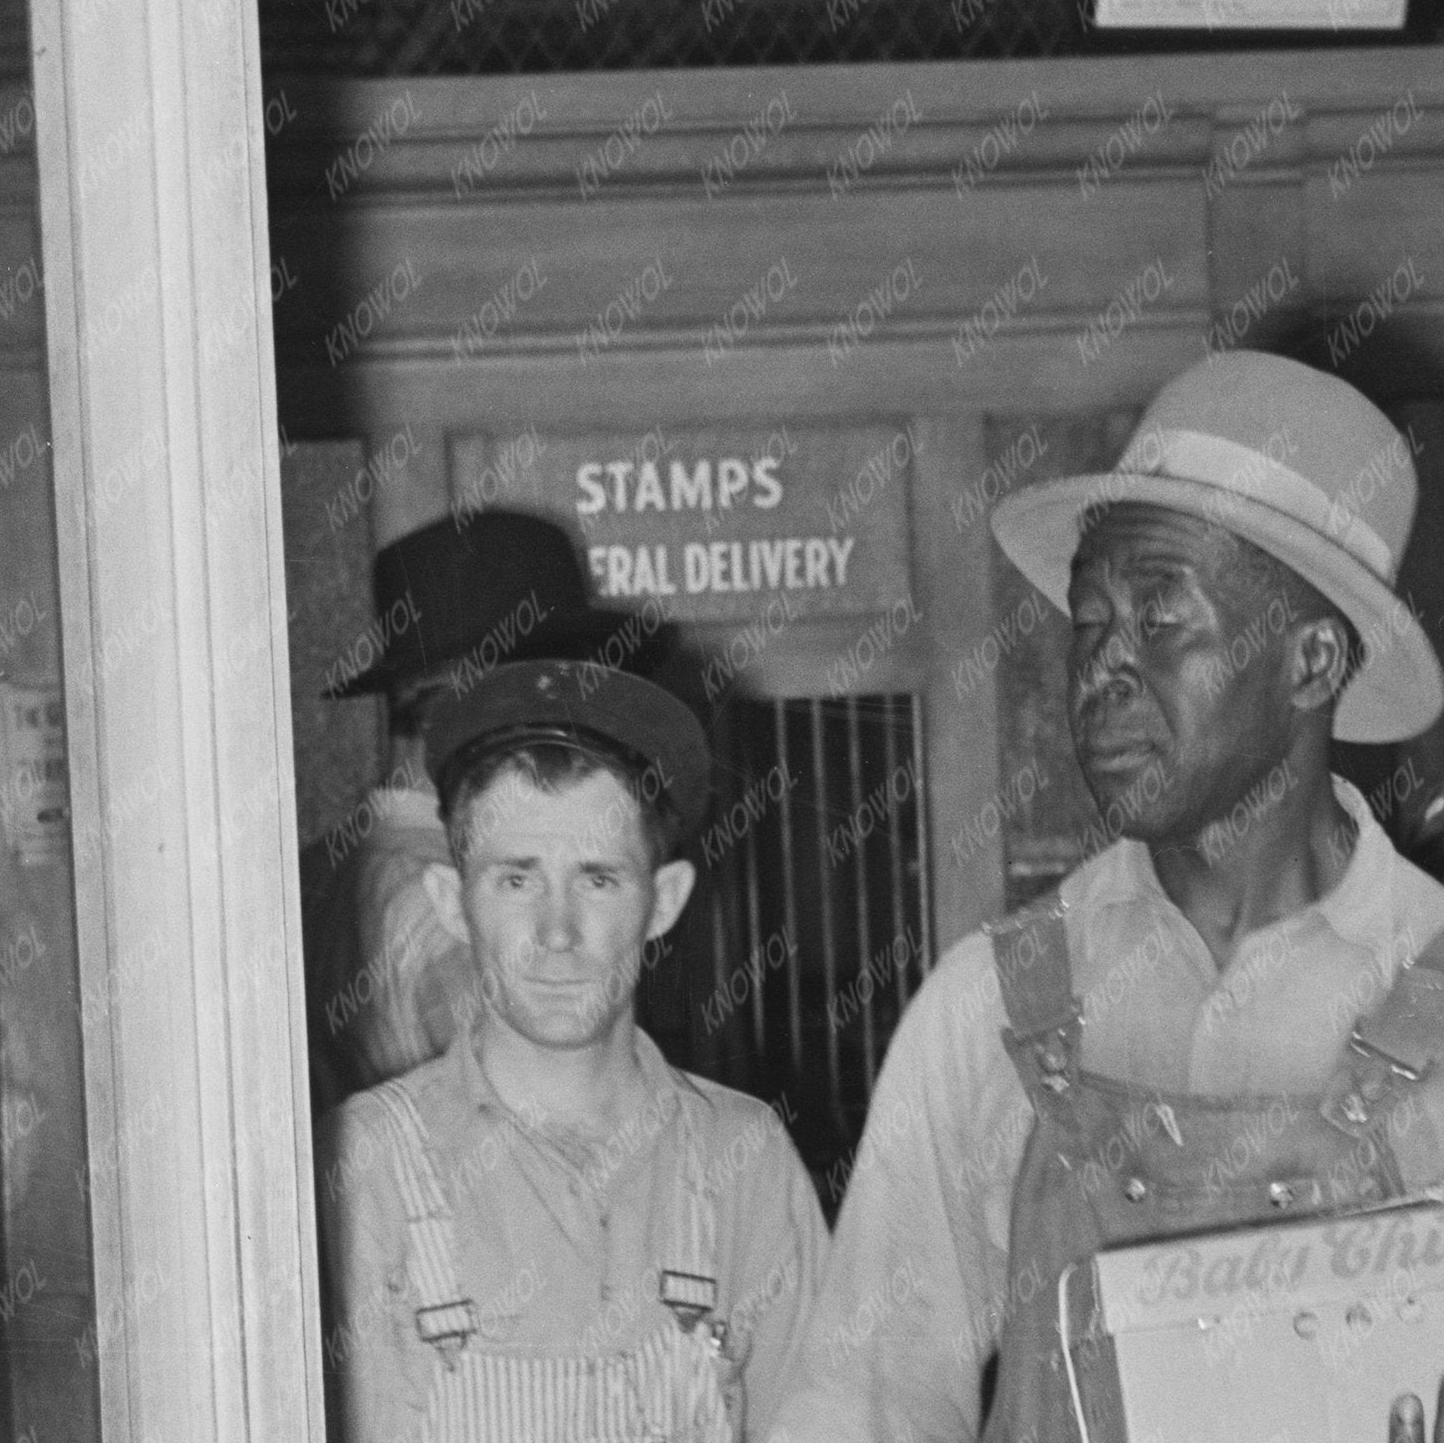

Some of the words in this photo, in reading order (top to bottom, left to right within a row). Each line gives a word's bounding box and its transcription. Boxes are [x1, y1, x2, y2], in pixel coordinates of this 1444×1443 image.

[575, 457, 784, 514] STAMPS
[684, 536, 856, 595] DELIVERY
[1137, 1230, 1310, 1305] Baby
